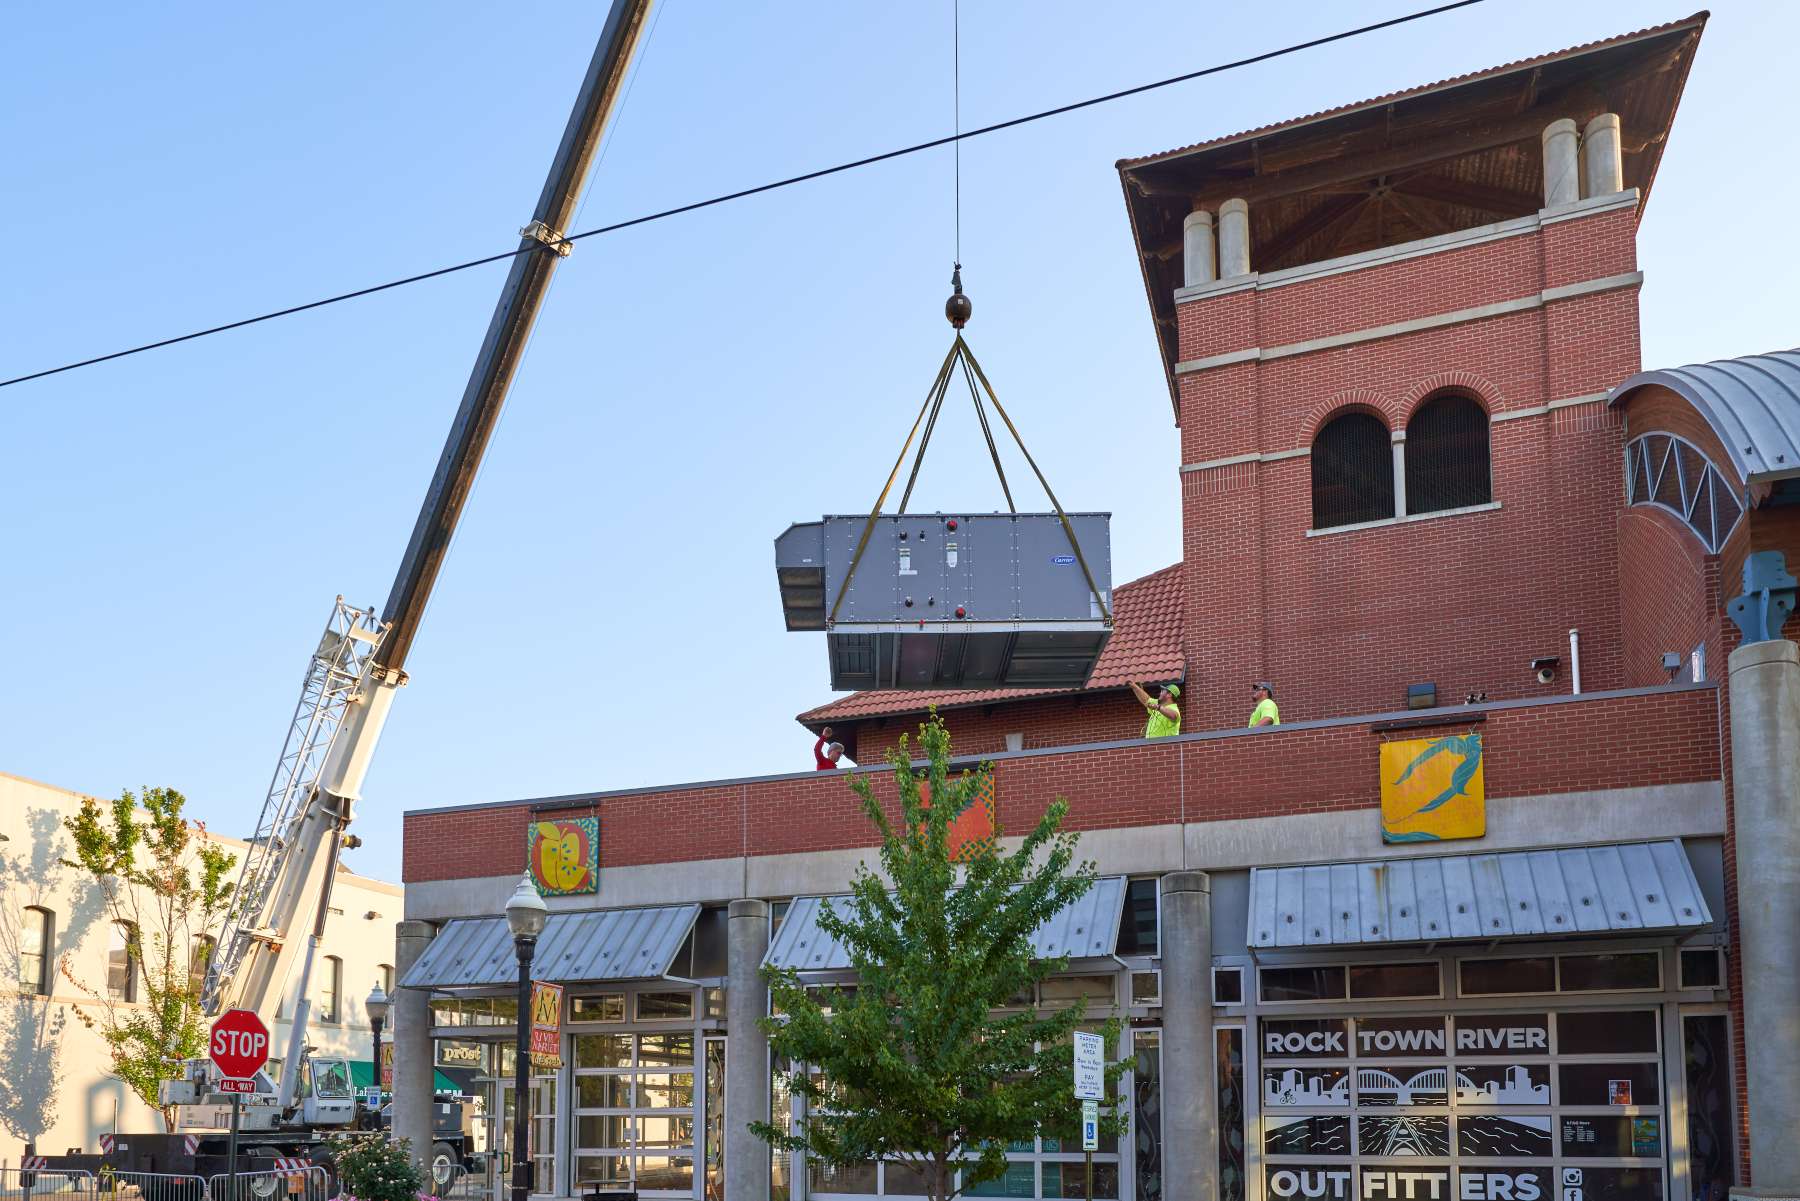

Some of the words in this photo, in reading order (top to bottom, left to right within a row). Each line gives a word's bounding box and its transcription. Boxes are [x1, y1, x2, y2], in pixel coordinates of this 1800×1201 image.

[213, 1030, 266, 1057] STOP
[1266, 1032, 1344, 1052] ROCK
[1358, 1030, 1445, 1050] TOWN
[1457, 1028, 1546, 1049] RIVER
[222, 1081, 235, 1090] ALL
[239, 1082, 253, 1091] WAY
